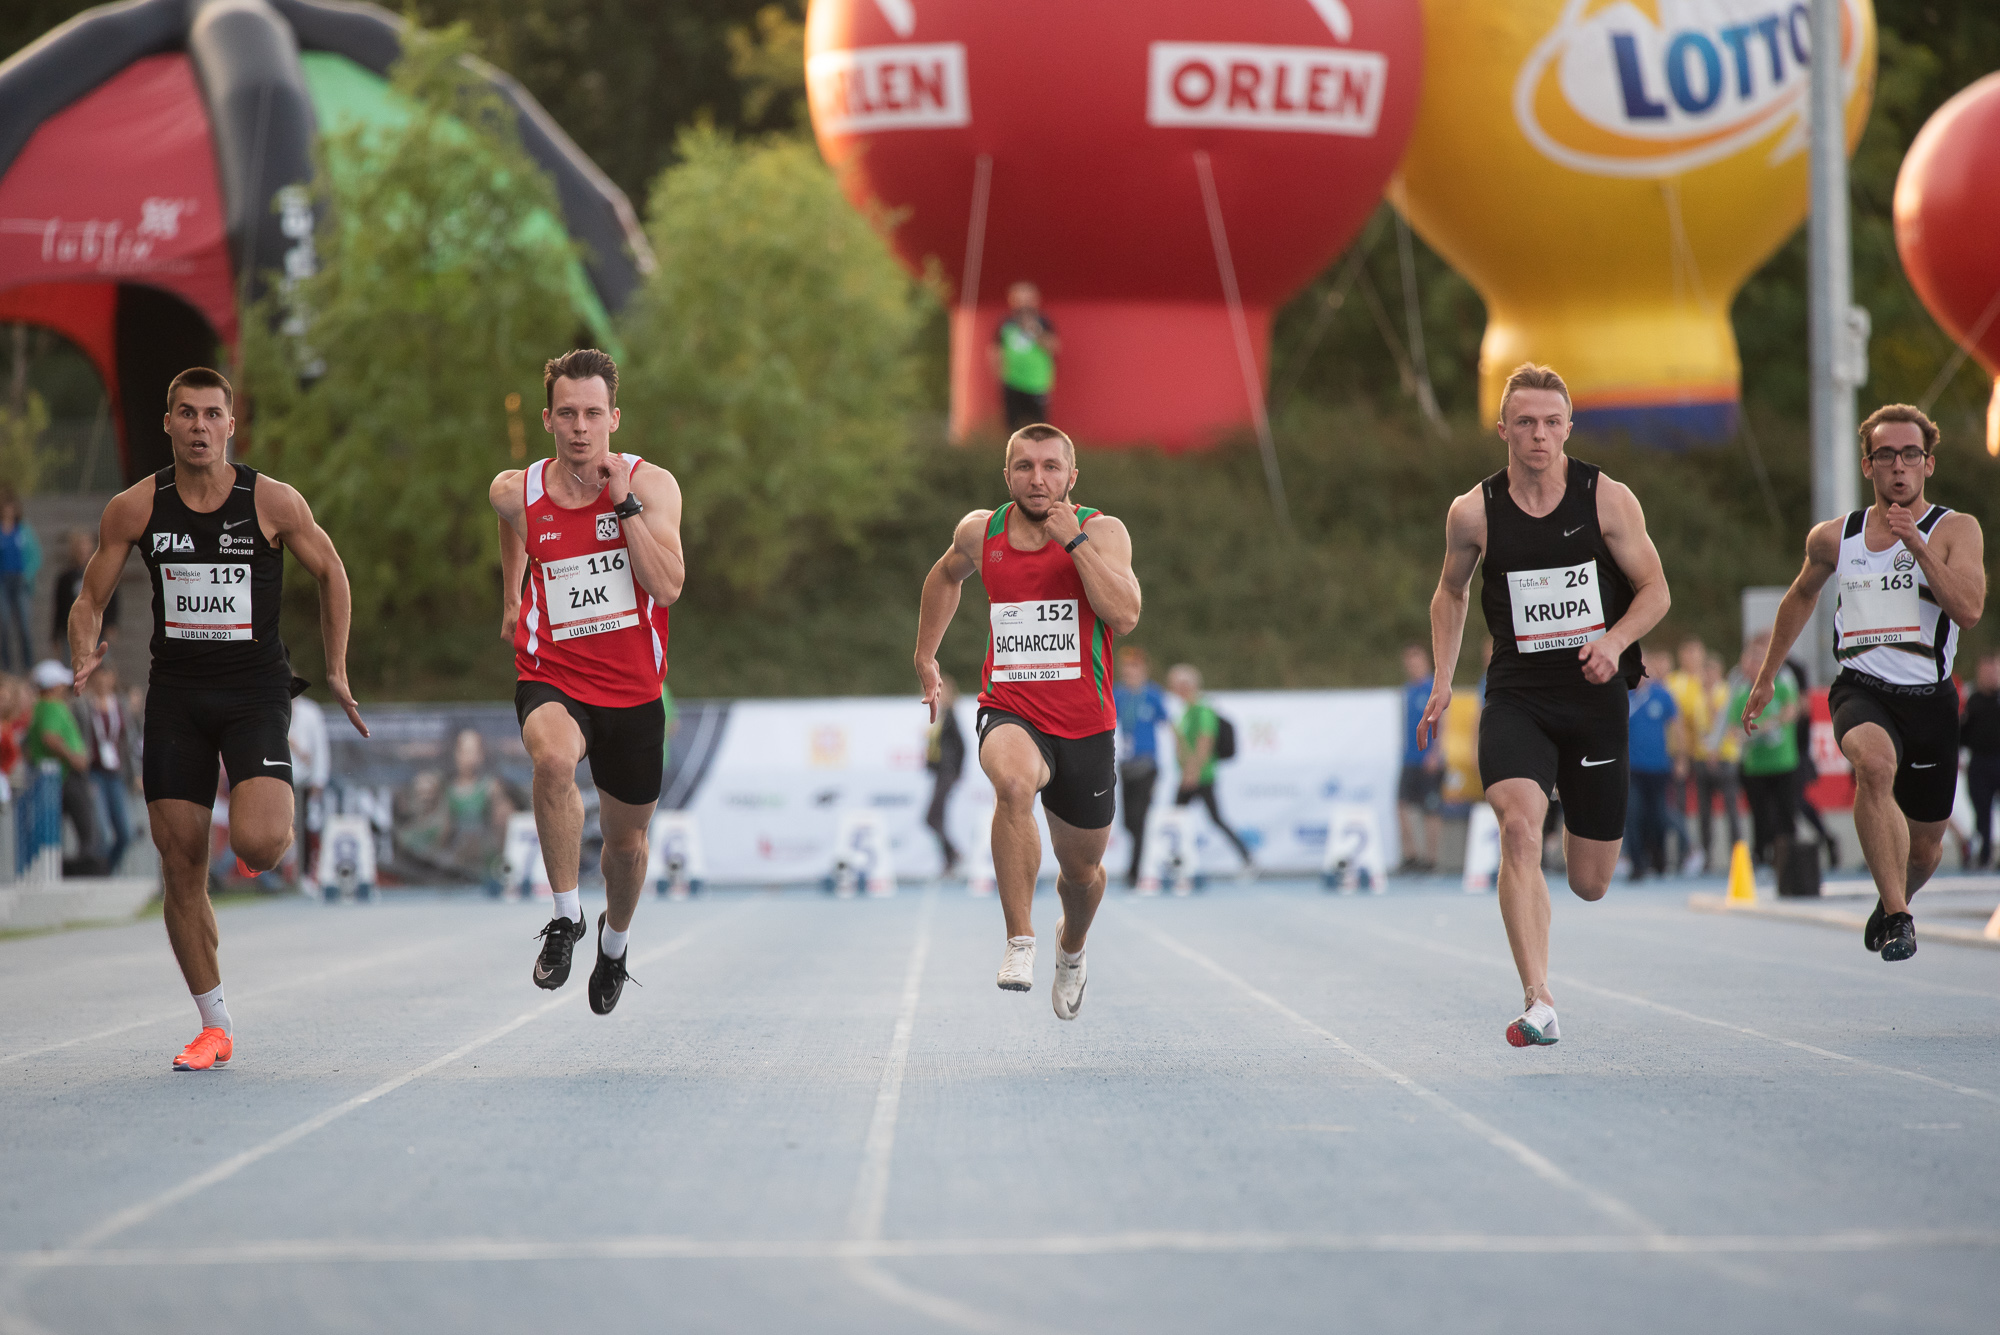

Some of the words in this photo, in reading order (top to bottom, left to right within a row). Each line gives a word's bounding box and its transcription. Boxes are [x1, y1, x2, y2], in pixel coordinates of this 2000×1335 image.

[1173, 62, 1371, 118] ORLEN
[540, 532, 561, 543] pts
[587, 553, 625, 575] 116
[210, 568, 245, 584] 119
[1565, 567, 1589, 588] 26
[1880, 573, 1914, 591] 163
[176, 595, 236, 613] BUJAK
[569, 585, 610, 609] ŻAK
[1002, 610, 1018, 618] PGE
[1036, 603, 1074, 622] 152
[1524, 598, 1591, 623] KRUPA
[181, 631, 209, 639] LUBLIN
[211, 631, 232, 640] 2021
[568, 624, 598, 637] LUBLIN
[600, 620, 621, 631] 2021
[996, 633, 1076, 653] SACHARCZUK
[1534, 638, 1565, 650] LUBLIN
[1567, 635, 1589, 646] 2021
[1856, 635, 1881, 645] LUBLIN
[1883, 633, 1902, 642] 2021
[1008, 671, 1037, 680] LUBLIN
[1039, 670, 1060, 679] 2021
[1854, 672, 1894, 693] NIKE
[1896, 686, 1937, 697] PRO
